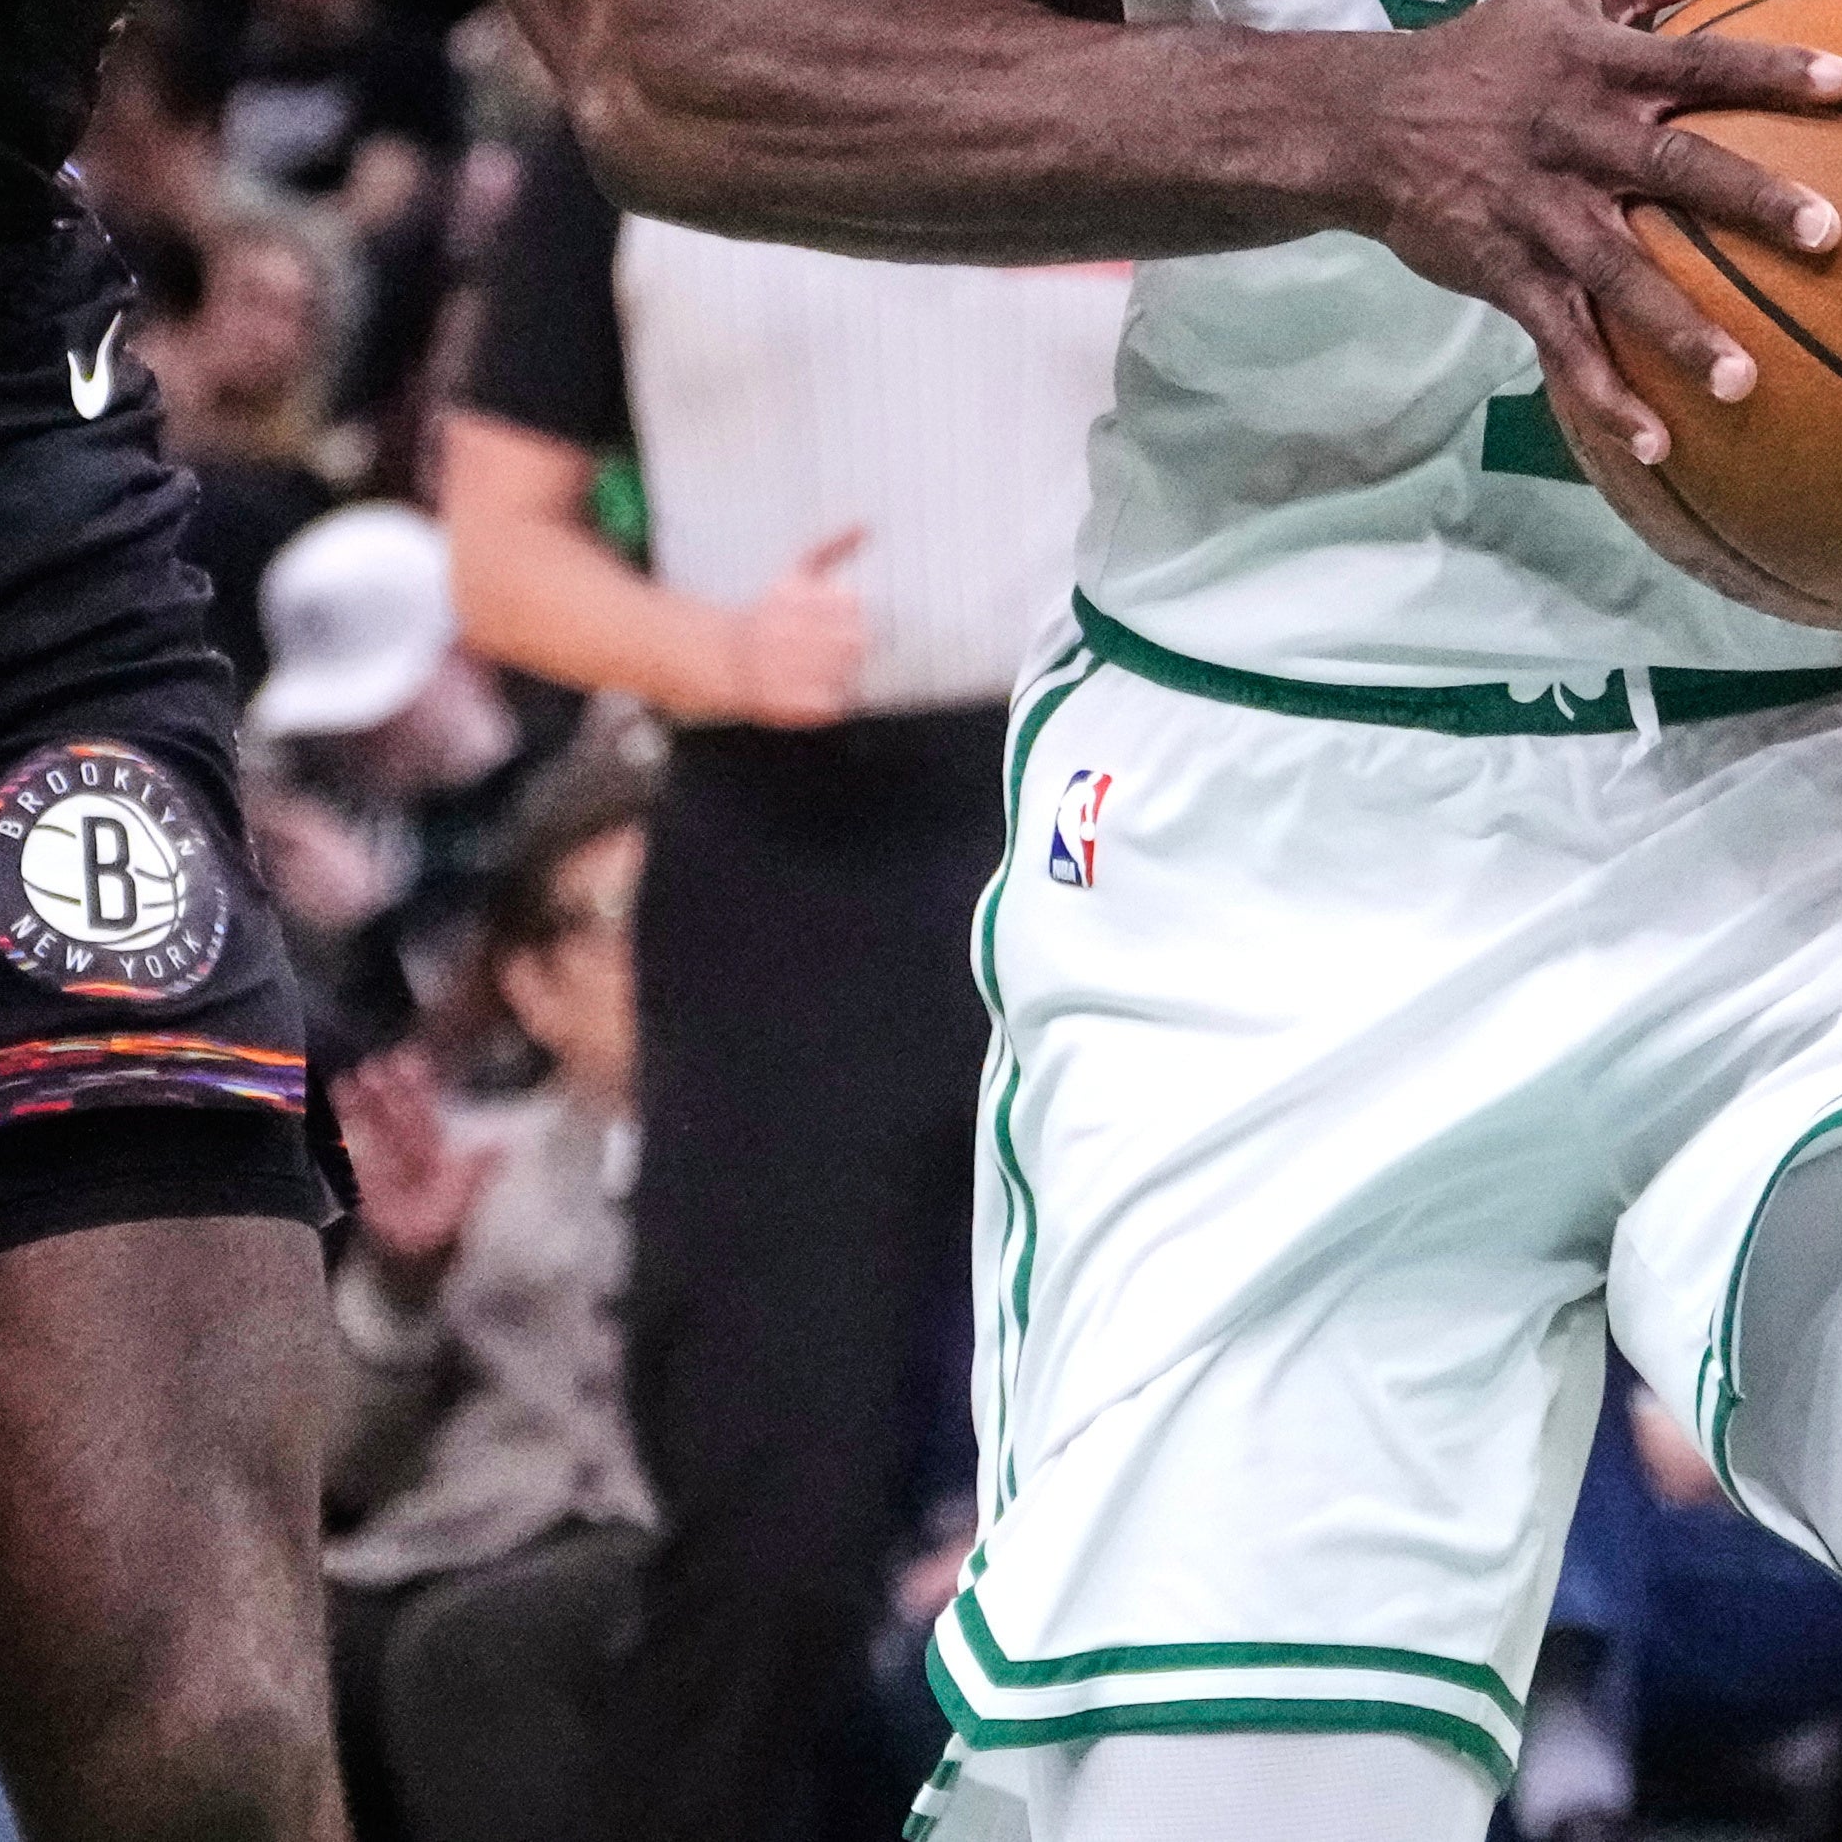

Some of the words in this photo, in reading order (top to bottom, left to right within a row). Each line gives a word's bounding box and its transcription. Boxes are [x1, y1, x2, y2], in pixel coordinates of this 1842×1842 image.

[81, 815, 137, 931] B
[10, 914, 94, 973] NEW
[119, 929, 202, 980] YORK
